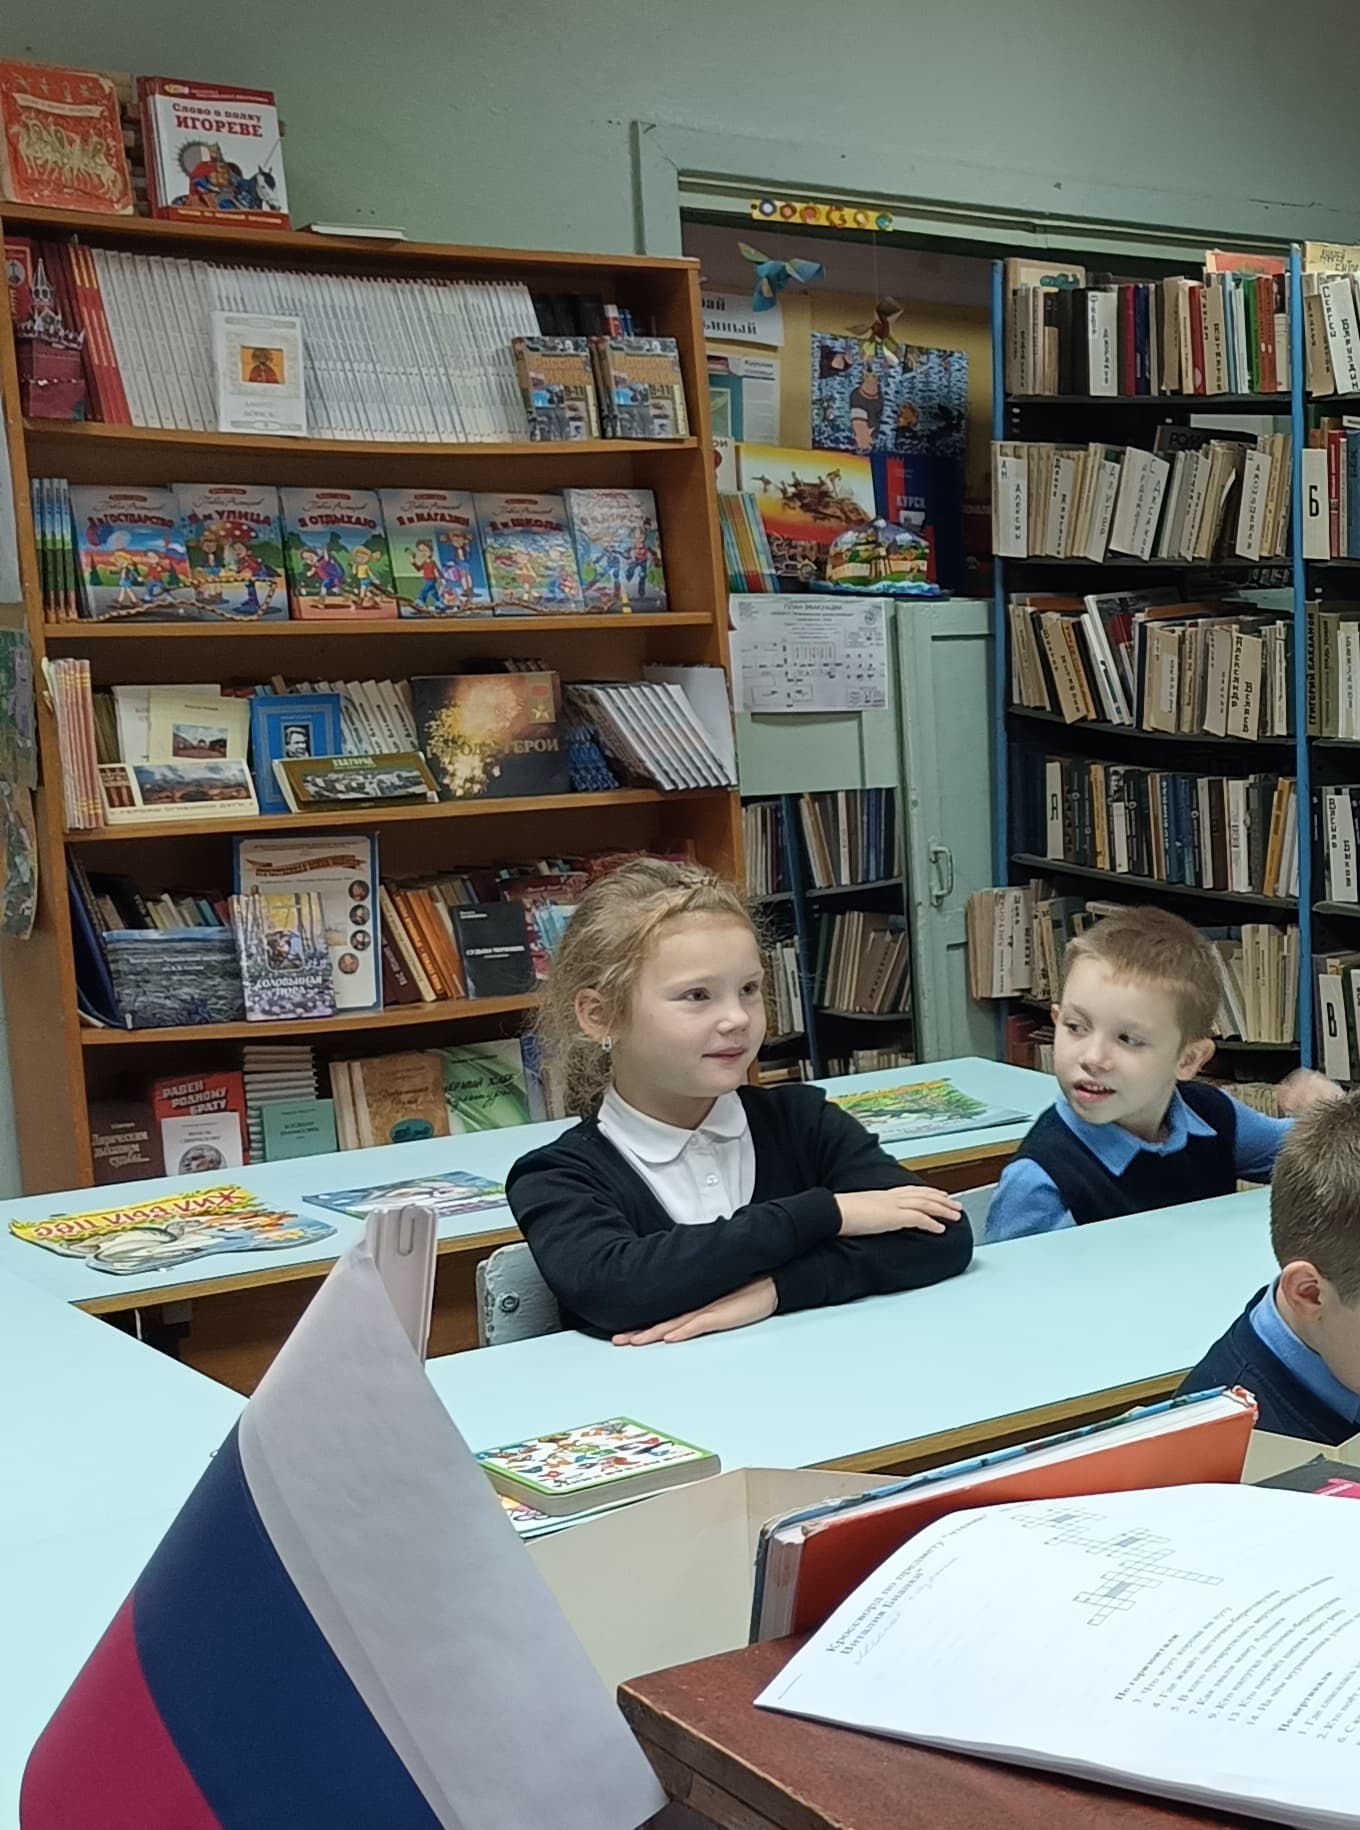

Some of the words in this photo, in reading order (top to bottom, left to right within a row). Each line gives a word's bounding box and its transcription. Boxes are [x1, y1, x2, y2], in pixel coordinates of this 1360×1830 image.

[172, 103, 211, 116] Слово
[224, 111, 262, 122] полку
[175, 115, 263, 138] ИГОРЕВЕ
[215, 510, 272, 527] УЛИЦА
[308, 514, 377, 529] ОТДЫХАЮ
[162, 1079, 204, 1099] РАВЕН
[171, 1087, 228, 1108] РОДНОМУ
